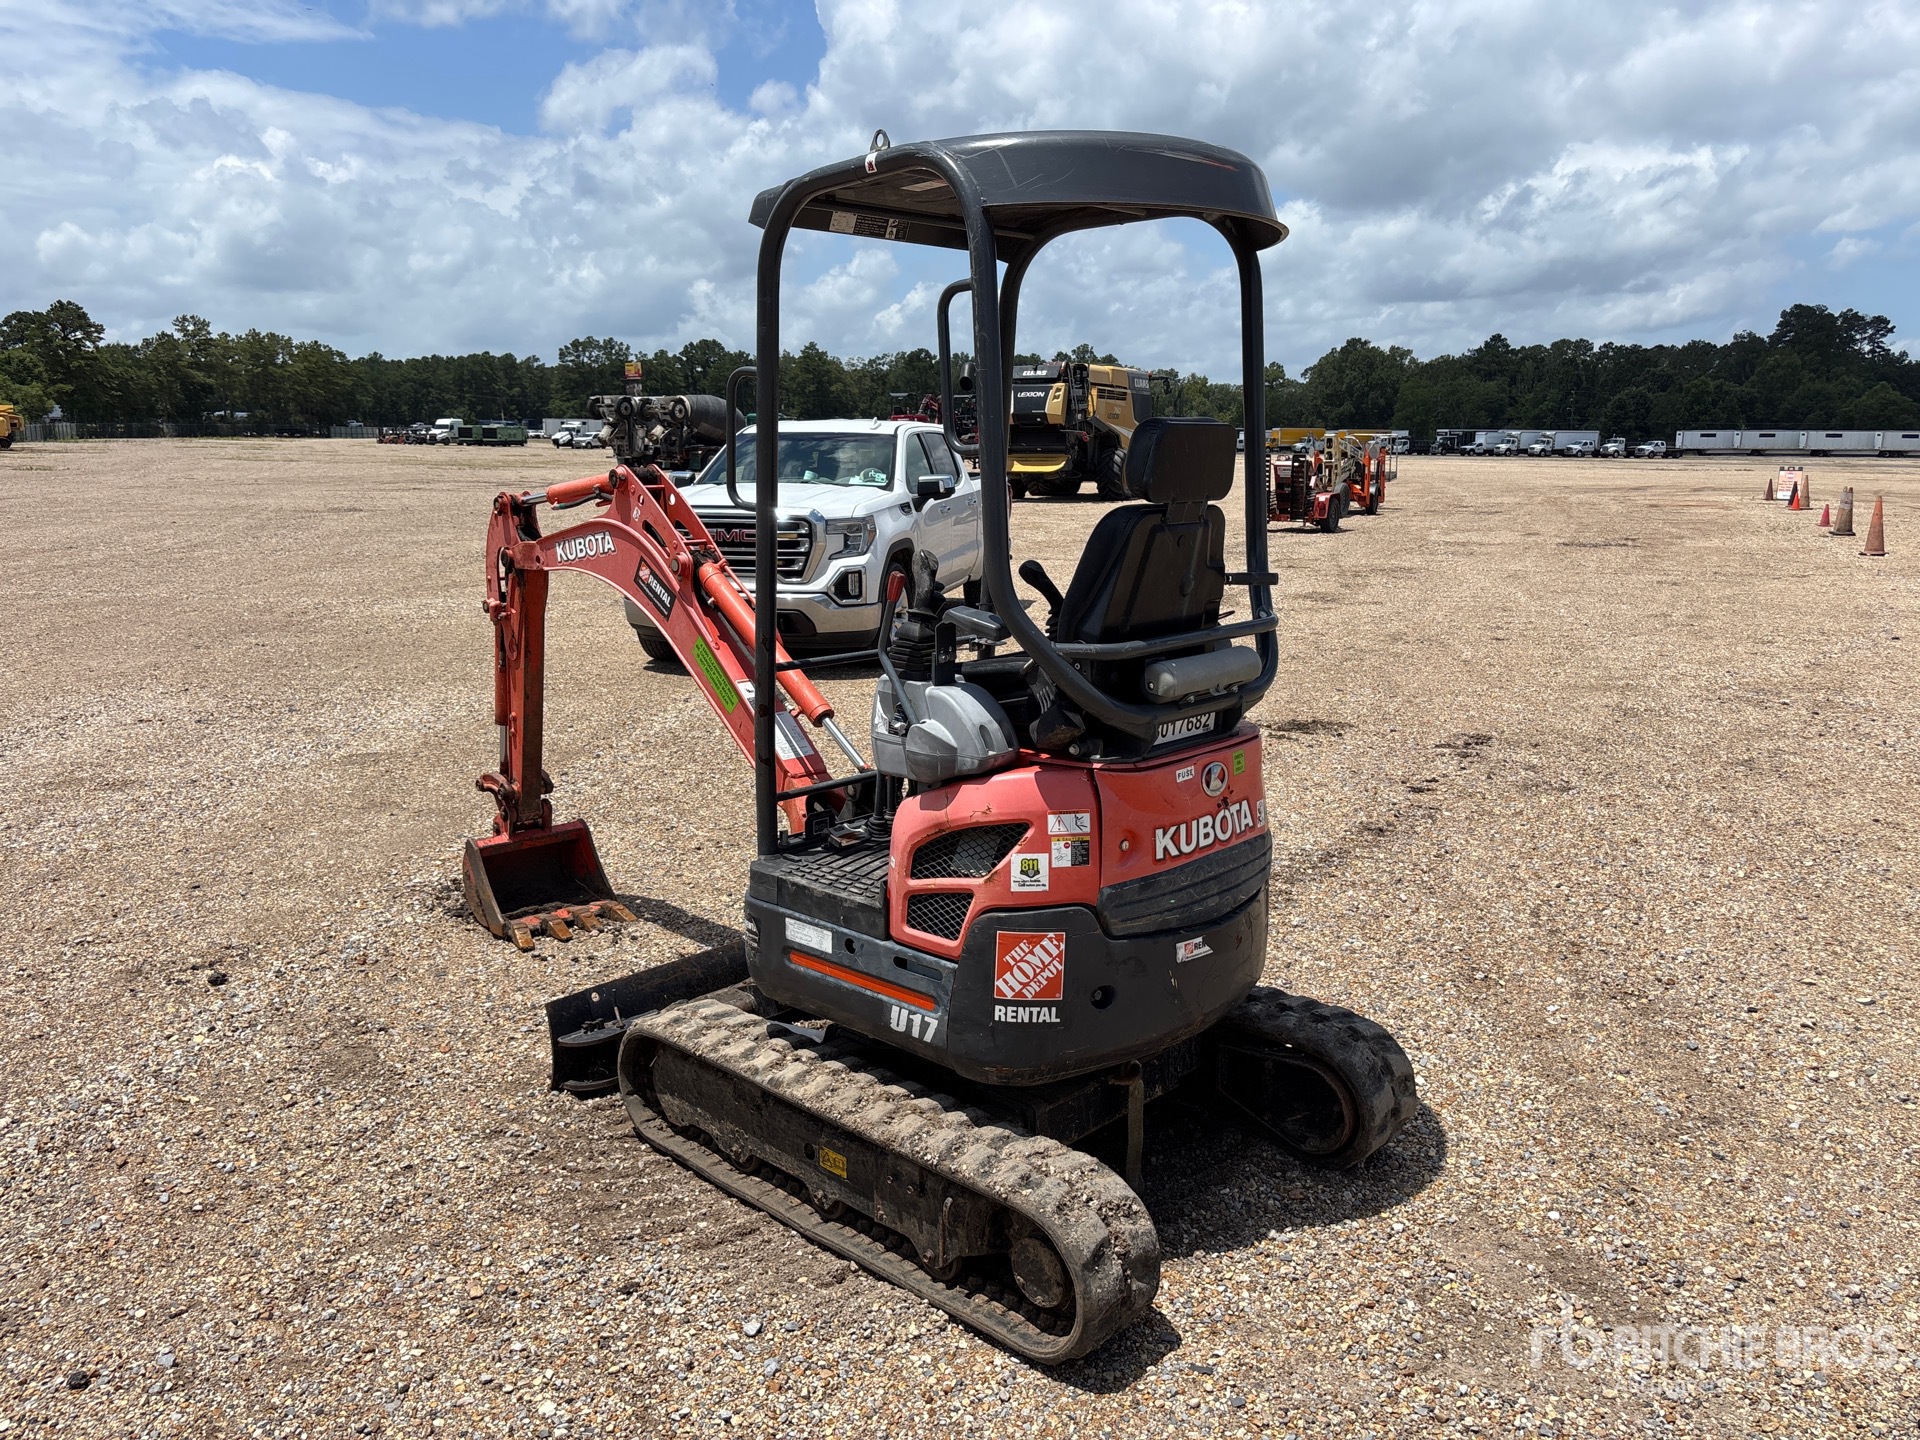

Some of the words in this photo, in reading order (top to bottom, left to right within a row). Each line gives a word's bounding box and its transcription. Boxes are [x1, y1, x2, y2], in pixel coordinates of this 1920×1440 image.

[555, 530, 616, 562] KUBOTA
[648, 575, 671, 608] RENTAL
[1177, 768, 1194, 780] FUSE
[1155, 799, 1254, 860] KUBOTA
[1021, 859, 1038, 871] 811
[996, 933, 1064, 998] HOME
[1003, 940, 1032, 966] THE
[1021, 958, 1063, 999] DEPOT
[890, 1005, 938, 1043] U17
[994, 1005, 1060, 1023] RENTAL
